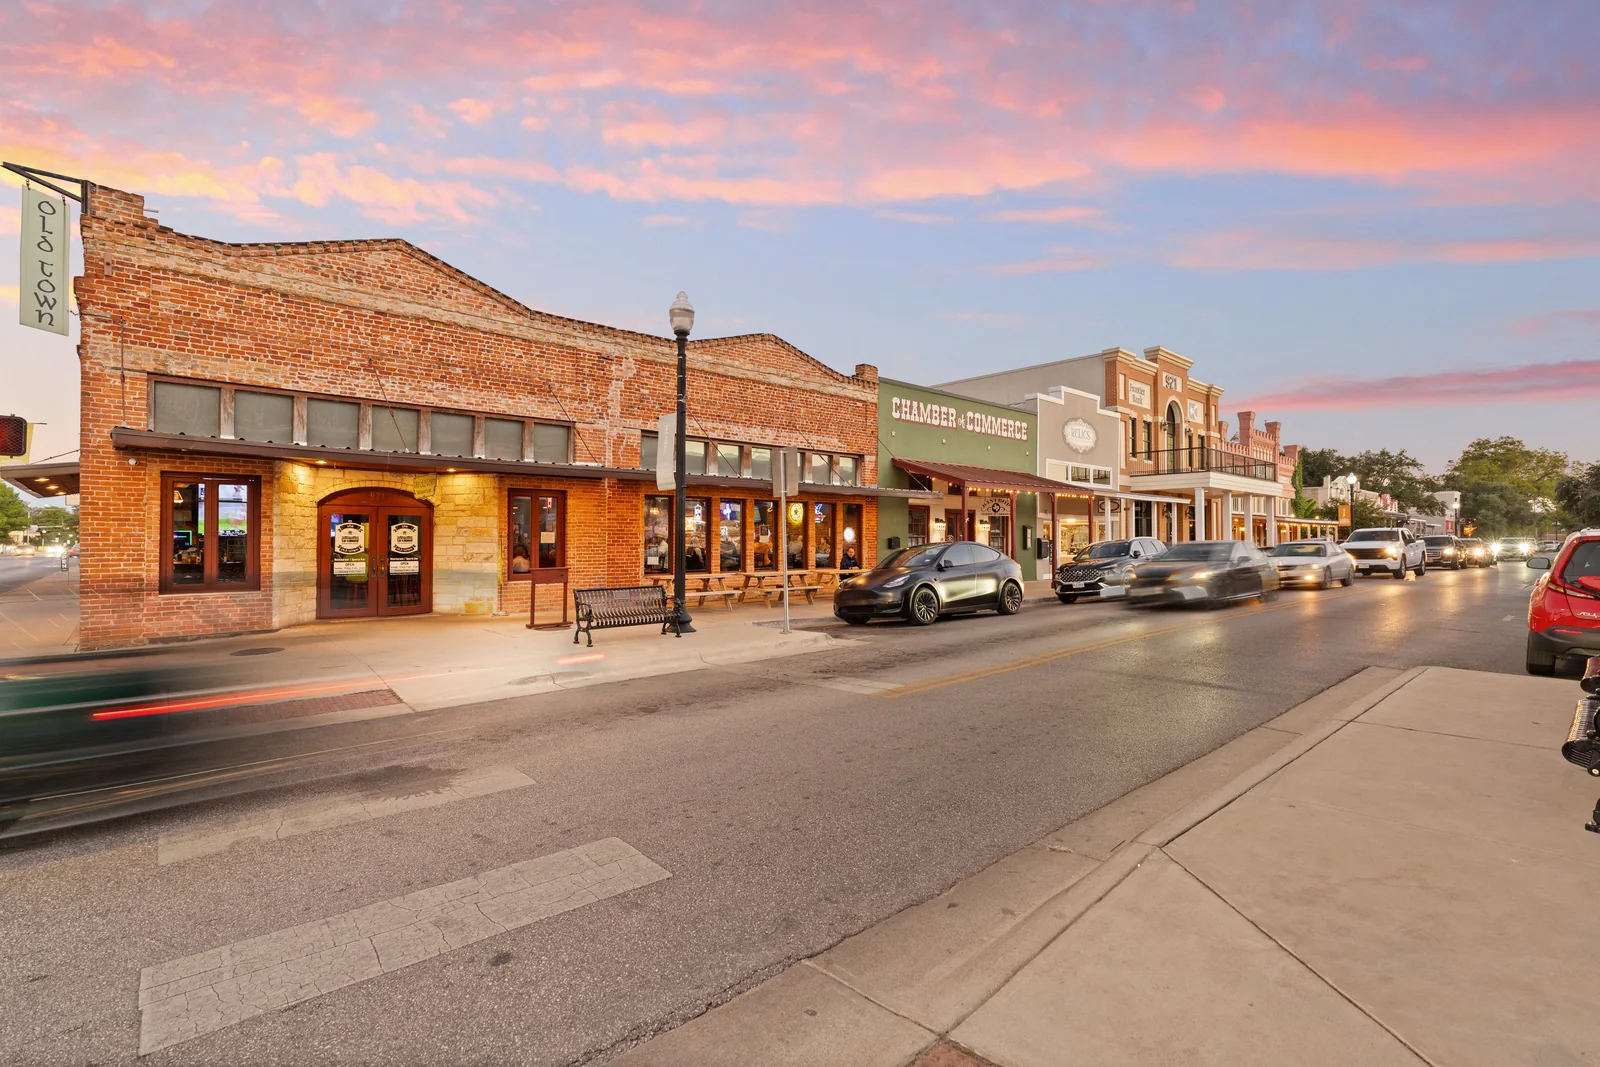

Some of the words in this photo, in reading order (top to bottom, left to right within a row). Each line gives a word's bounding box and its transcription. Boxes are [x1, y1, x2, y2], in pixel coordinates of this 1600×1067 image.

[1129, 383, 1146, 397] Frontier
[1165, 374, 1177, 391] 921
[1132, 393, 1144, 406] Bank
[891, 396, 957, 429] CHAMBER
[966, 411, 1028, 441] COMMERCE
